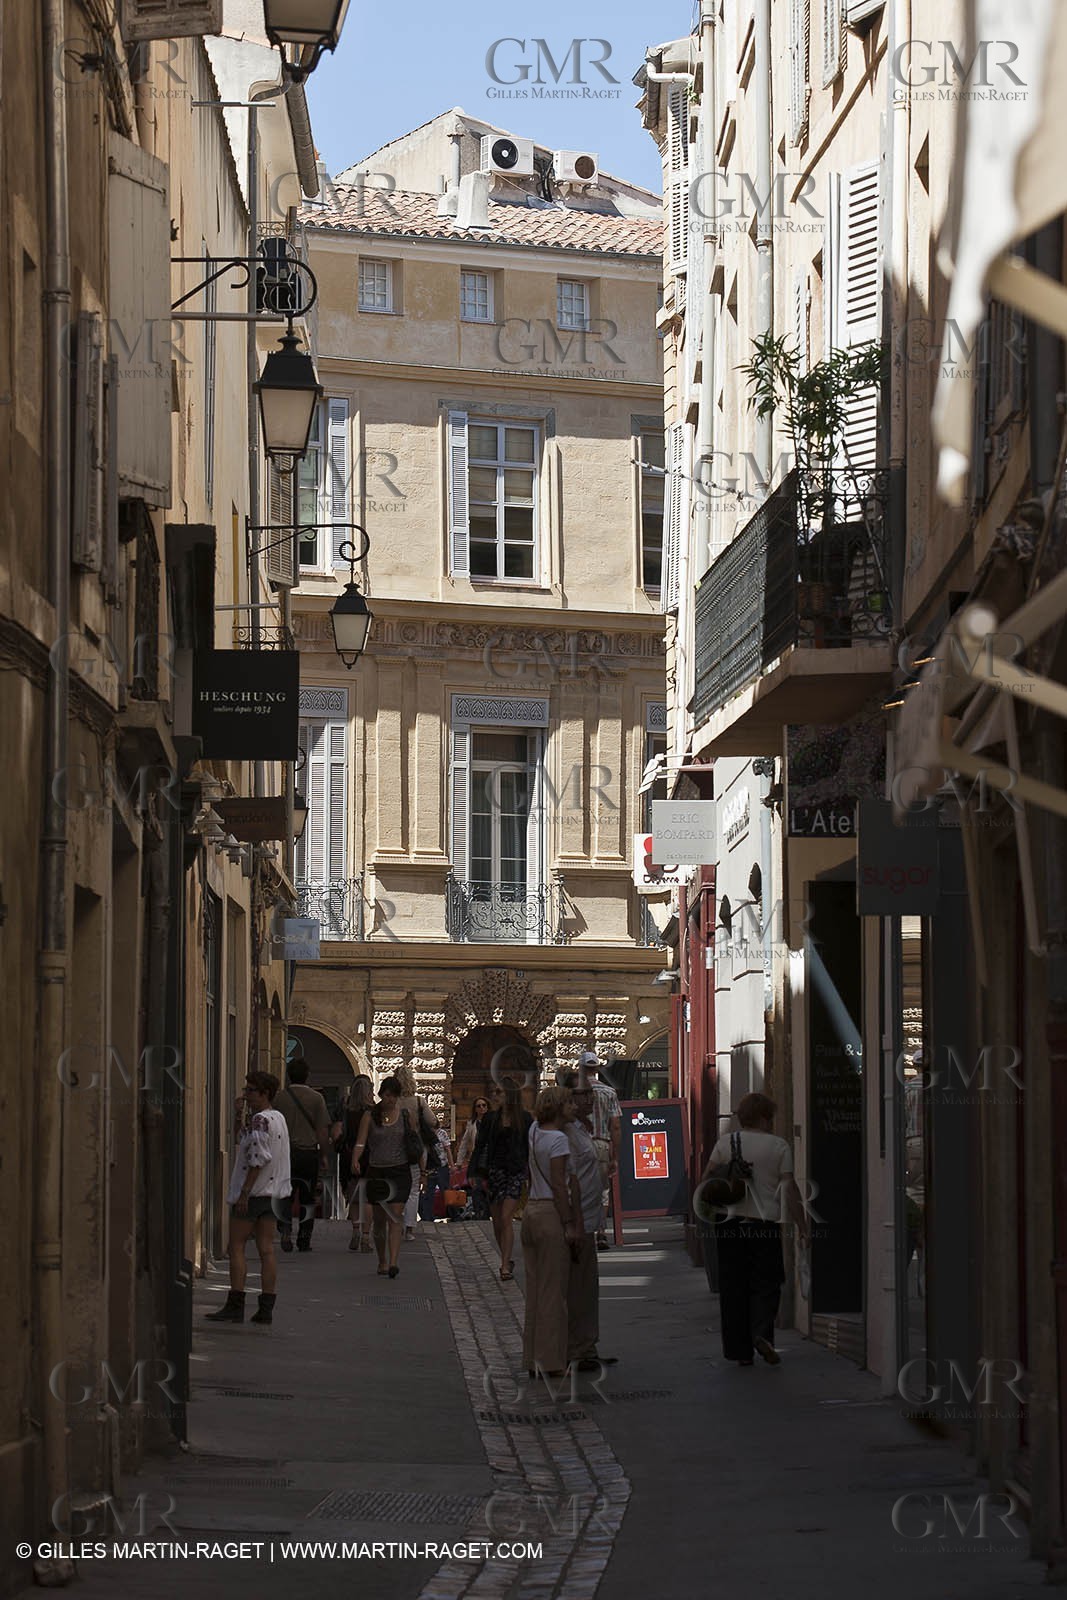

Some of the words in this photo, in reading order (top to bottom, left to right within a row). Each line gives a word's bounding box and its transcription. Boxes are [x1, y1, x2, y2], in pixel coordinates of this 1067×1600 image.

[200, 691, 286, 702] HESCHUNG
[253, 705, 271, 714] 1934
[671, 813, 700, 824] ERIC
[655, 830, 715, 840] BOMPARD
[863, 866, 932, 895] sugar
